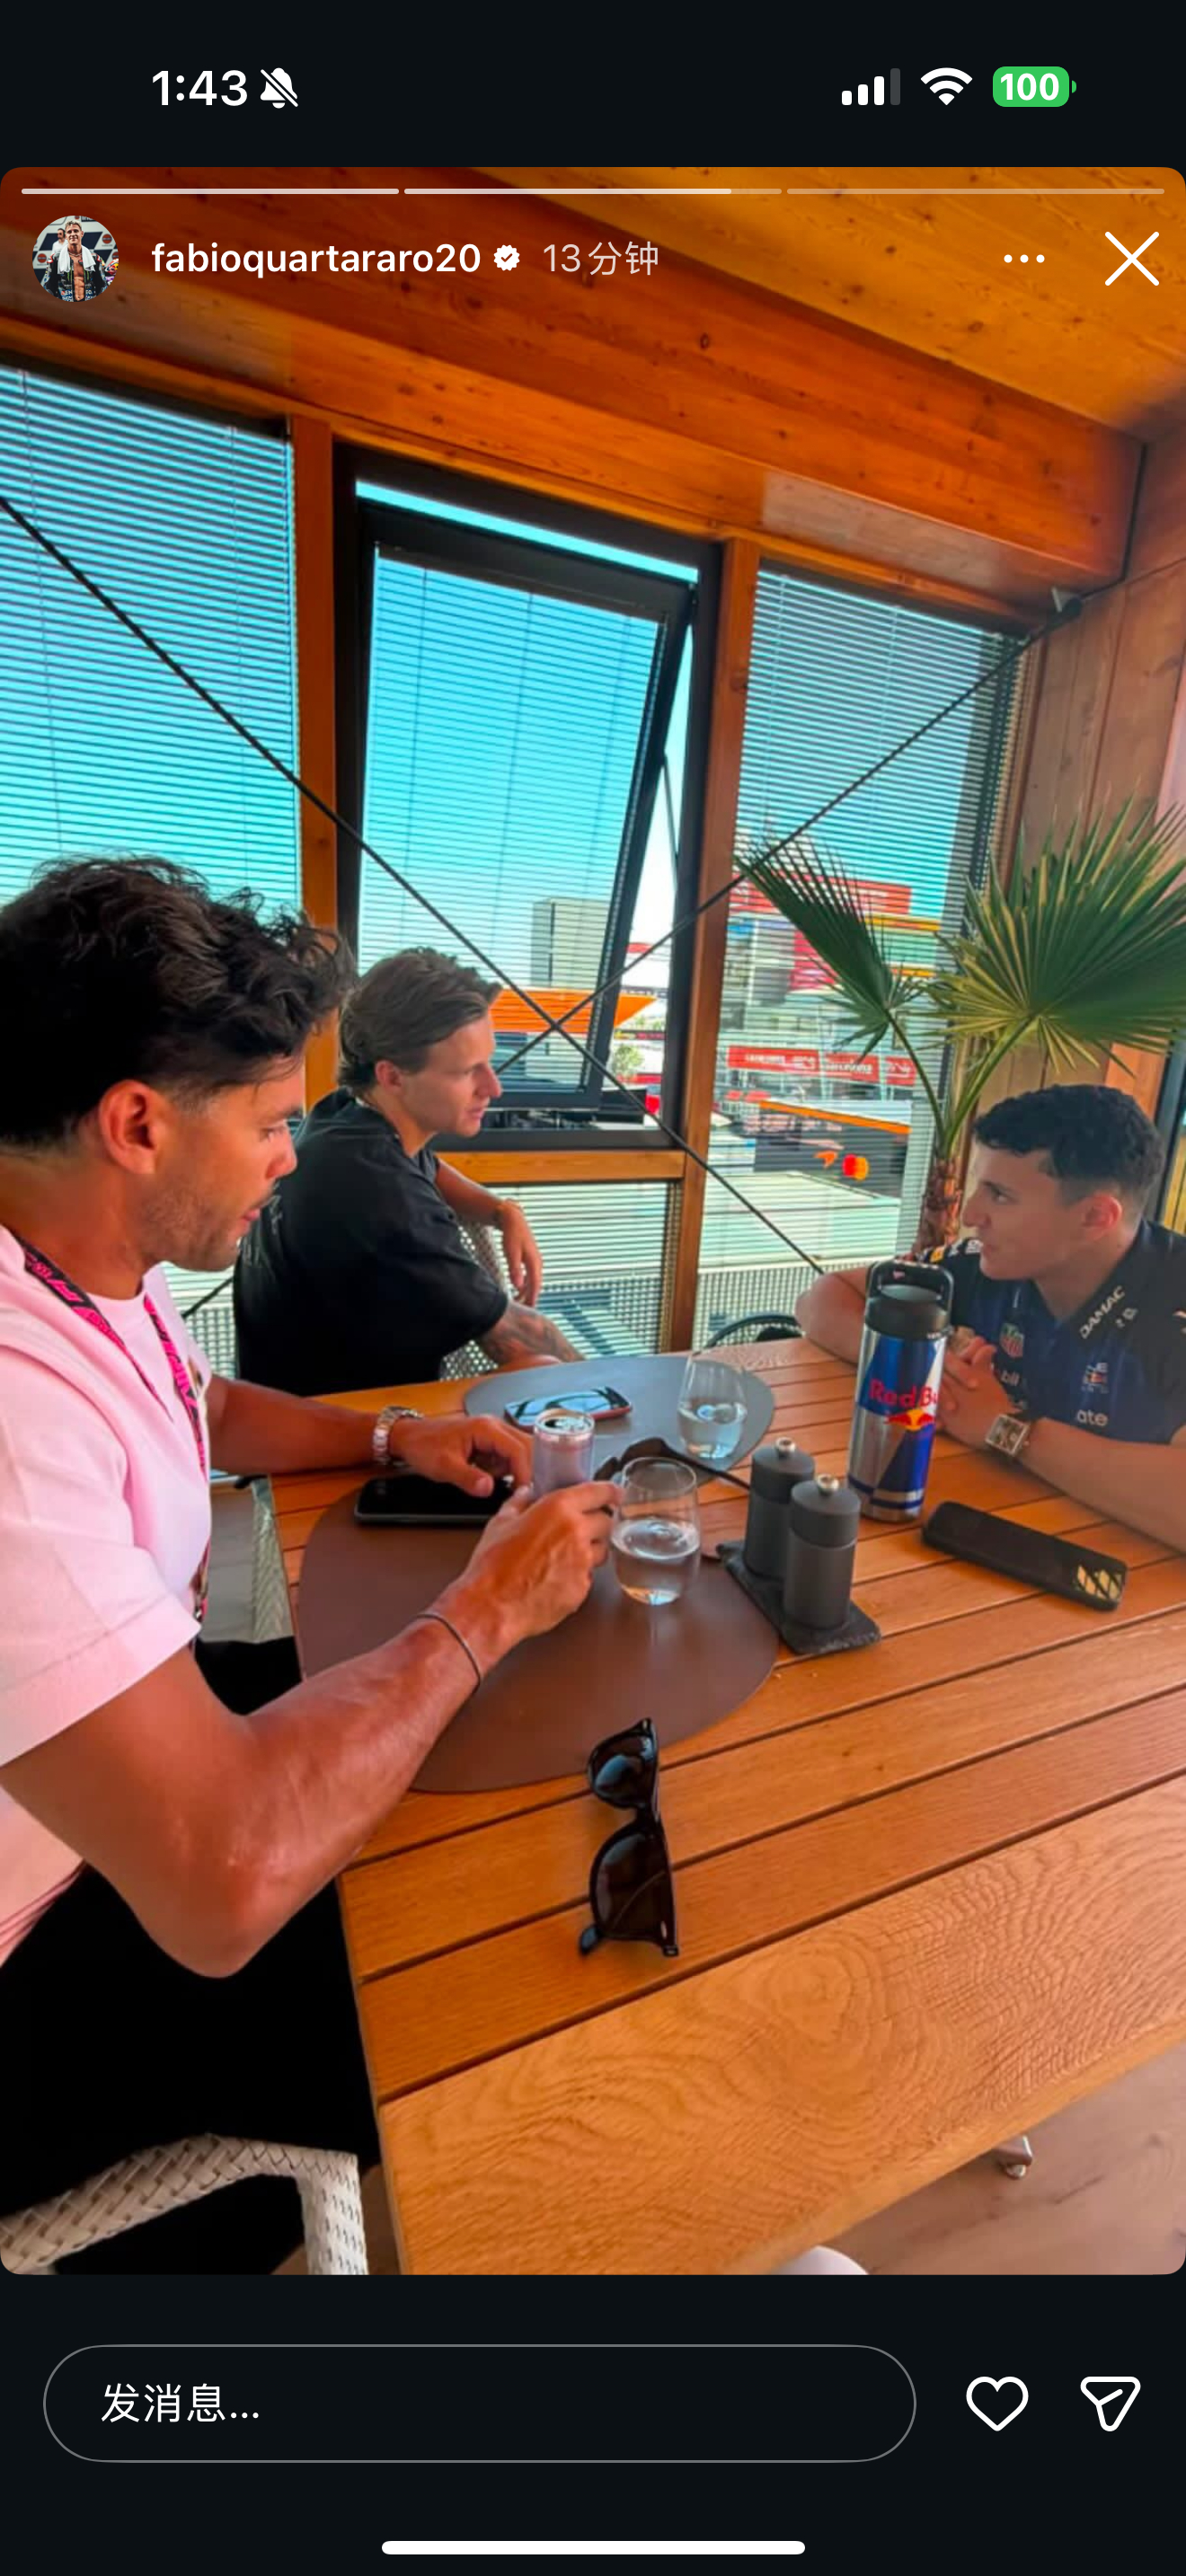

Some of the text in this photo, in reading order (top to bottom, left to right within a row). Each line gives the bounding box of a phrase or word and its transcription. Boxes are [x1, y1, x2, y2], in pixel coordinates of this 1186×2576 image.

[1079, 1285, 1125, 1339] DAMAC
[869, 1378, 916, 1408] Red
[1077, 1409, 1108, 1426] ate
